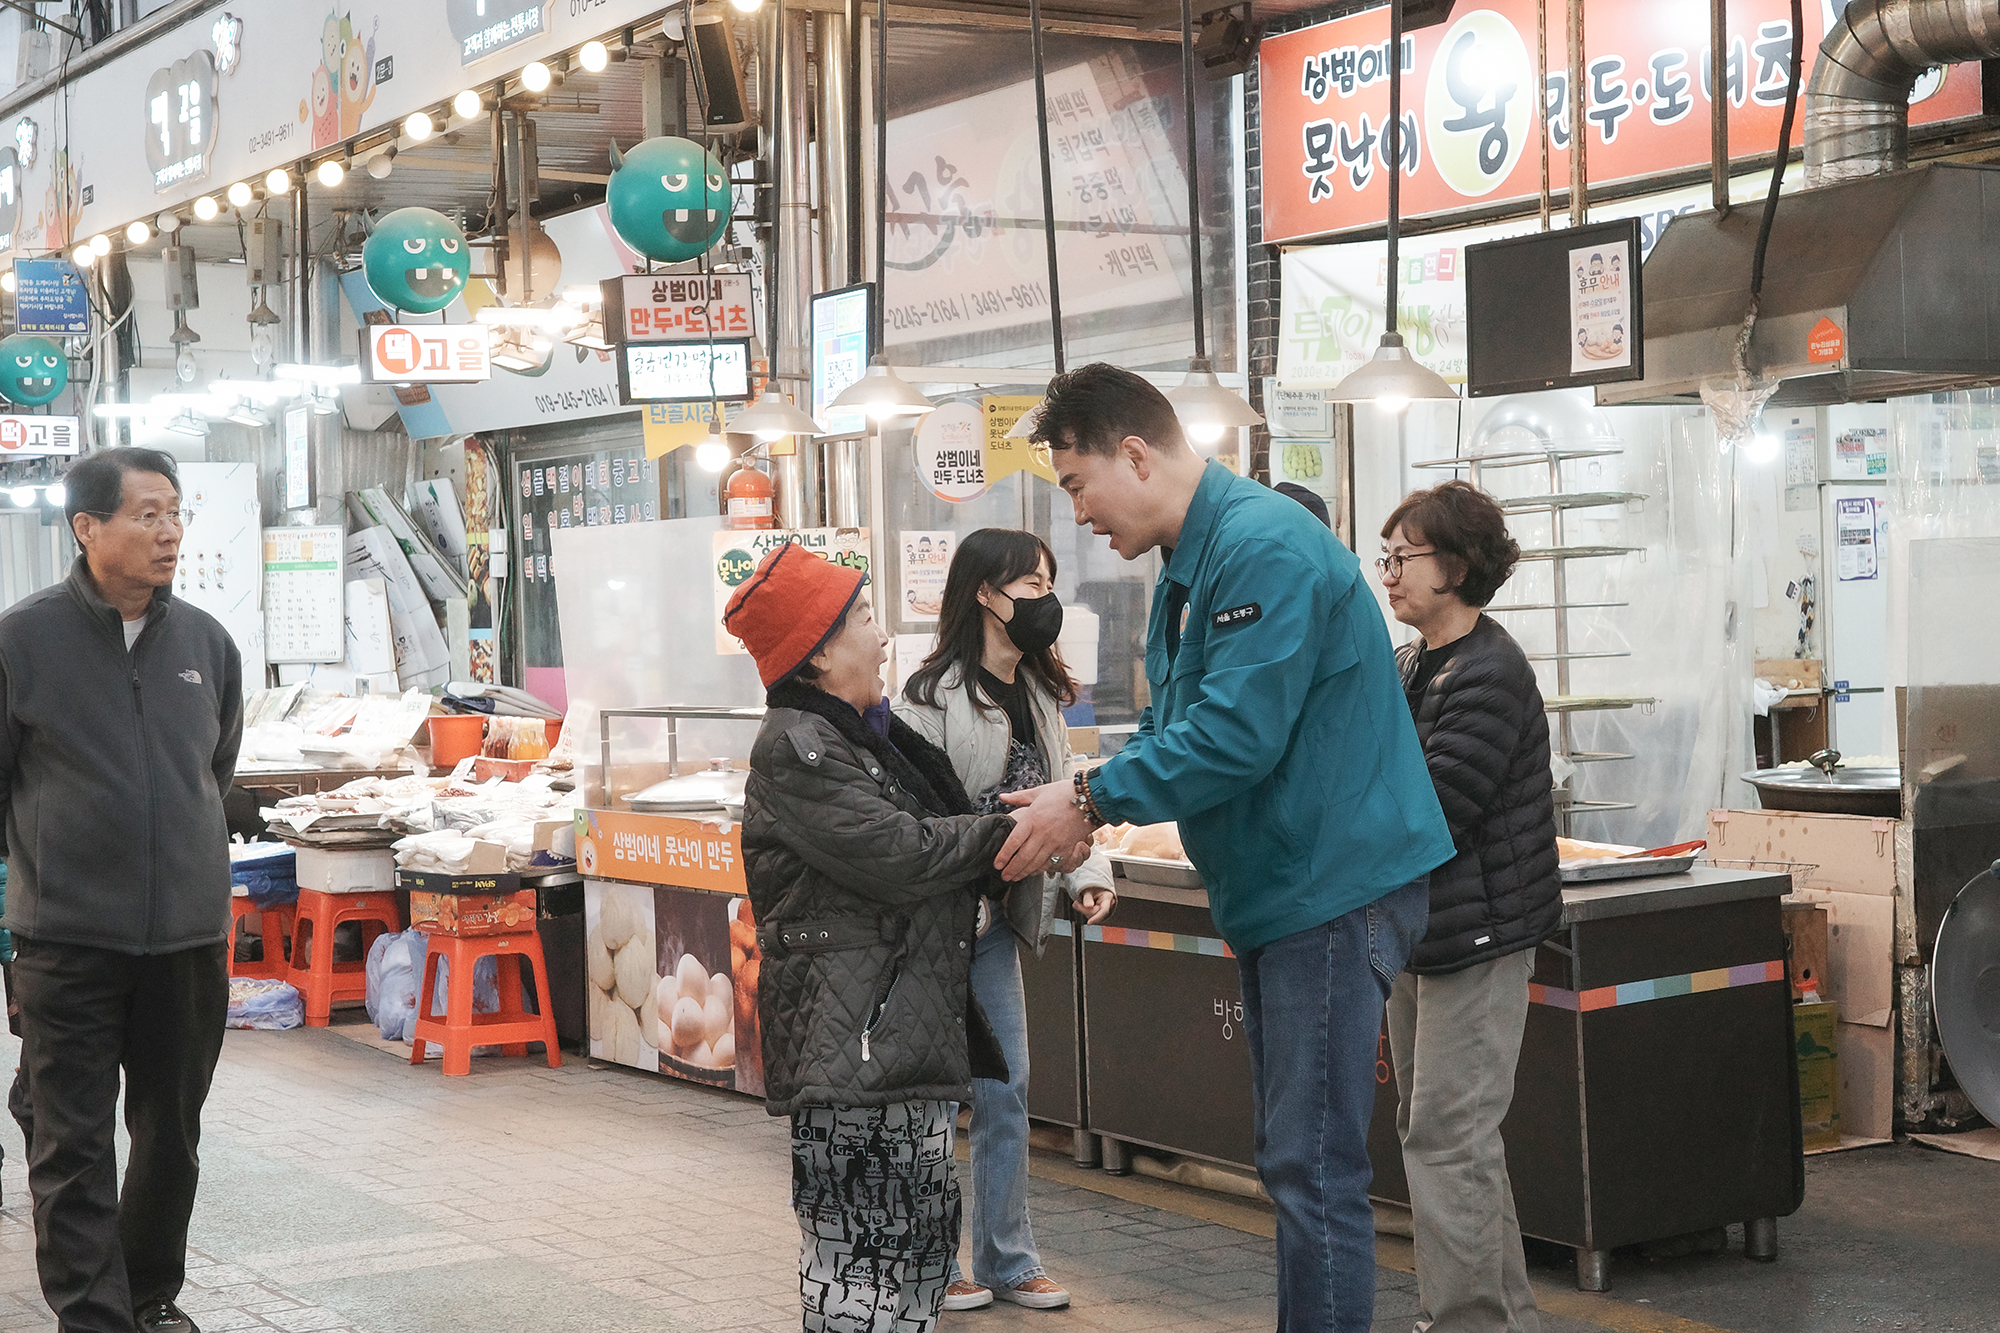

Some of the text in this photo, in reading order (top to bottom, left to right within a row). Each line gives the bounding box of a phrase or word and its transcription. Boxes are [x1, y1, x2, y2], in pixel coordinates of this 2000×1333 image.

[1304, 38, 1412, 100] 상범이네
[1304, 113, 1418, 199] 못난이
[1442, 31, 1519, 178] 왕
[248, 122, 295, 154] 02-3491-9611
[651, 279, 723, 303] 상범이네
[1578, 272, 1620, 295] 휴무 안내
[975, 281, 1049, 316] 3491-9611
[1344, 351, 1367, 361] Today
[535, 386, 609, 414] 019-245-2164
[650, 403, 719, 425] 단골시장
[990, 441, 1013, 451] 도너츠
[935, 449, 981, 469] 상범이네
[718, 558, 756, 582] 못난이
[907, 552, 946, 565] 휴무 안내
[1216, 606, 1254, 623] 서울 도봉구
[612, 830, 734, 873] 상범이네 못난이 만두
[474, 879, 497, 889] SPAM
